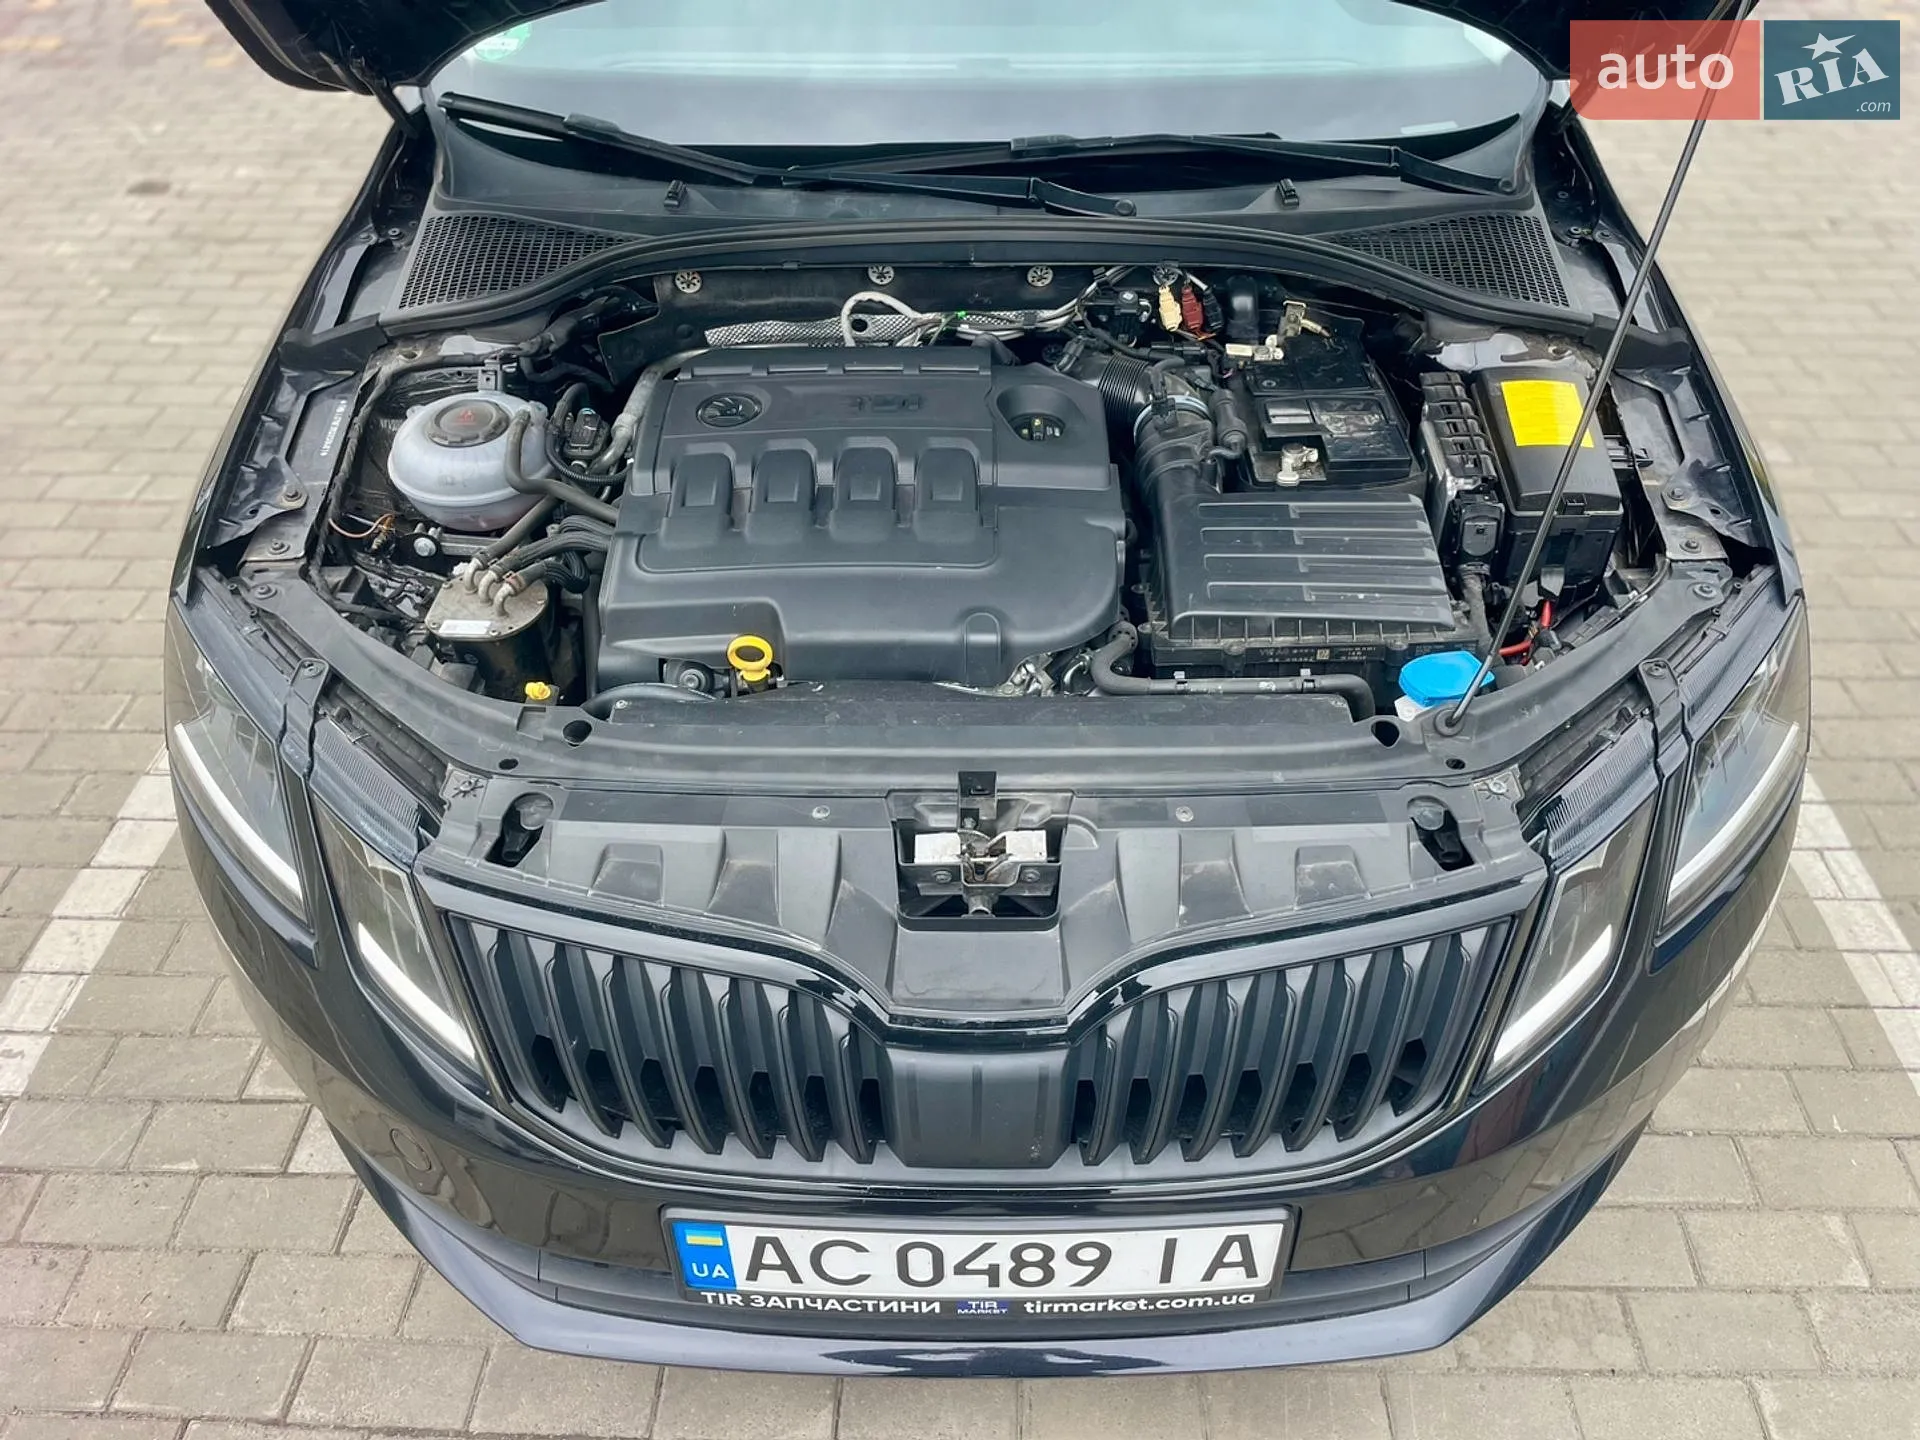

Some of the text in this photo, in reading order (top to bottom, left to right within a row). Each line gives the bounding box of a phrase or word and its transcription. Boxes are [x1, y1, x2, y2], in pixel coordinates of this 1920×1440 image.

[692, 1262, 730, 1279] UA
[745, 1234, 1258, 1289] AC 0489 IA
[701, 1291, 941, 1314] TIR ЗАПЧАСТИНИ
[967, 1301, 997, 1309] TIR
[1023, 1293, 1256, 1315] tirmarket.com.ua
